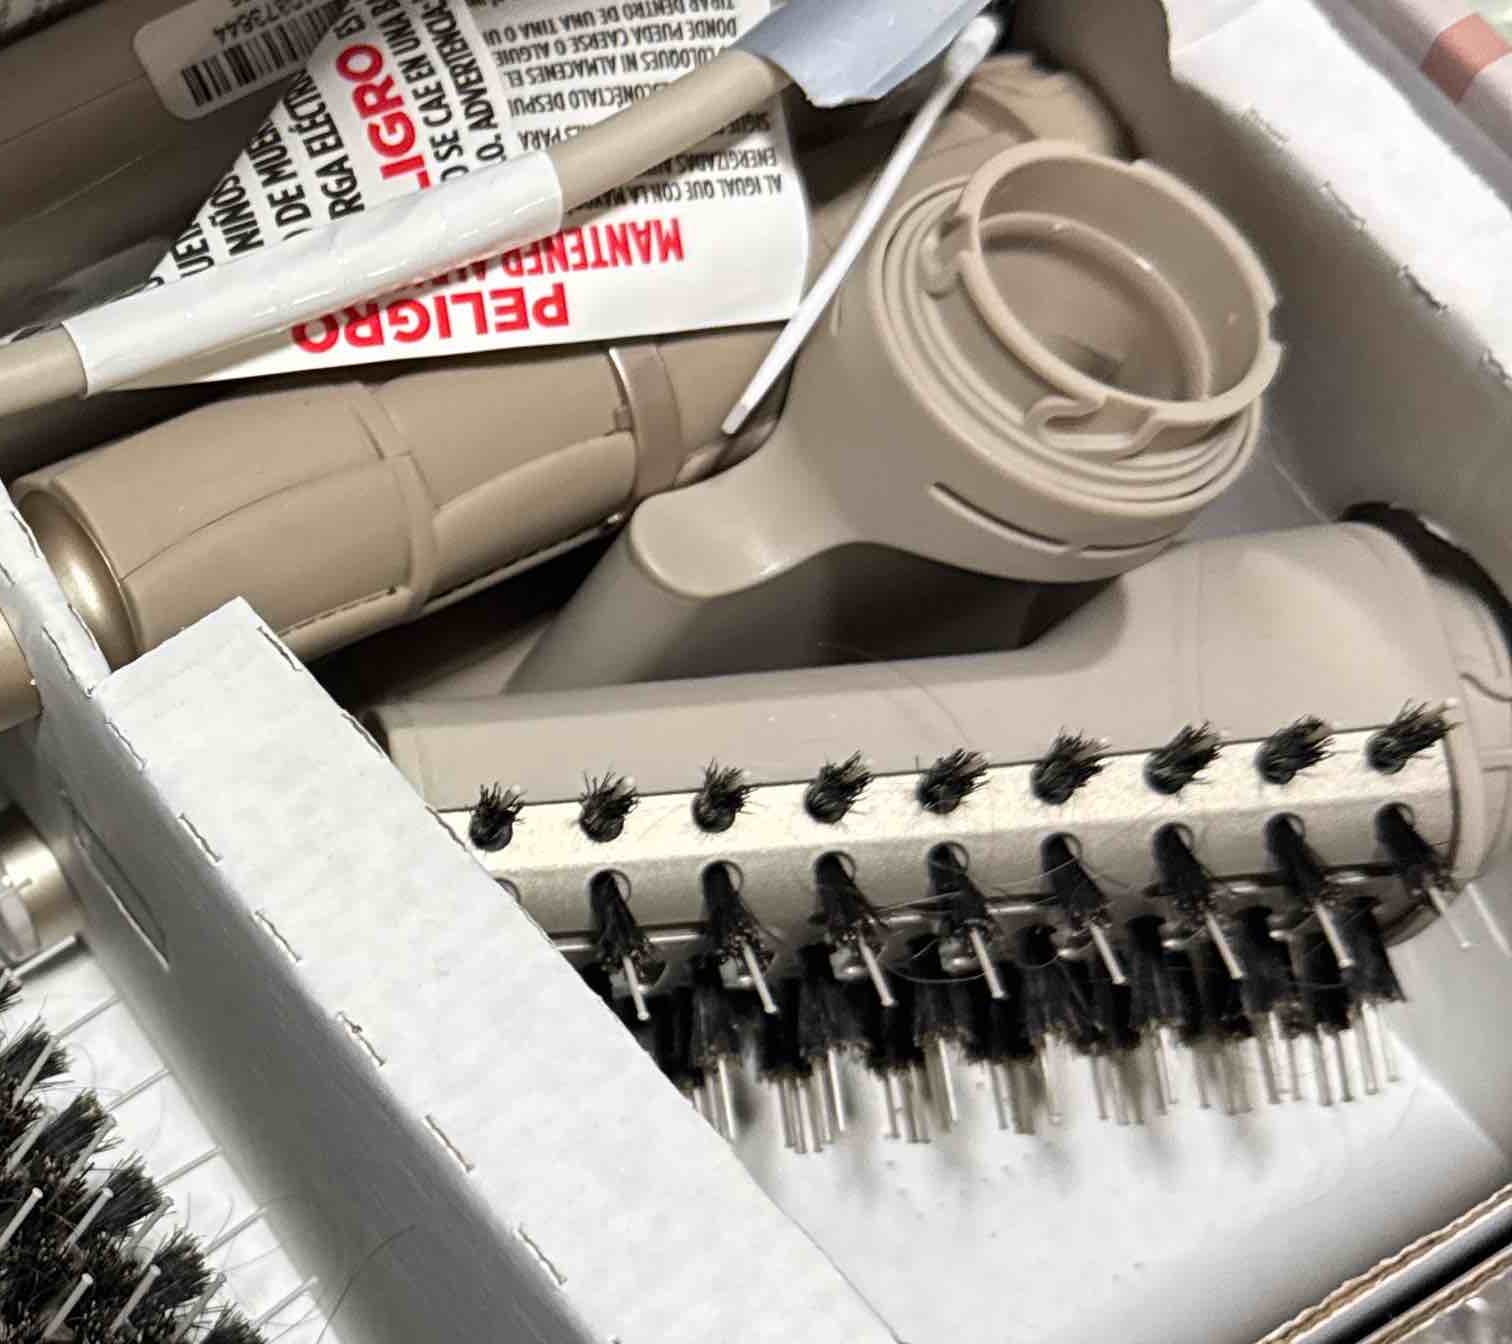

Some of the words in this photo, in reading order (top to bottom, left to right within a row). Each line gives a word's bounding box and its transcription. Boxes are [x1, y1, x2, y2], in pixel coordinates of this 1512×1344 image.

[517, 16, 556, 39] TINA
[557, 10, 594, 33] UNA
[595, 5, 619, 27] DE
[684, 15, 737, 39] DONDE
[381, 10, 423, 52] UNA
[503, 26, 516, 42] O
[567, 27, 629, 54] CAERSE
[631, 21, 682, 45] PUEDA
[552, 39, 566, 57] O
[400, 53, 436, 83] EN
[524, 54, 617, 86] ALMACENES
[619, 52, 637, 73] NI
[503, 69, 524, 88] EL
[412, 81, 451, 125] CAE
[431, 128, 463, 160] SE
[675, 144, 777, 176] ENERGIZADAS
[624, 183, 647, 206] LA
[647, 178, 682, 204] CON
[683, 177, 714, 202] QUE
[715, 173, 761, 199] IGUAL
[760, 172, 782, 194] AL
[267, 184, 311, 226] DE
[289, 281, 570, 355] PELIGRO
